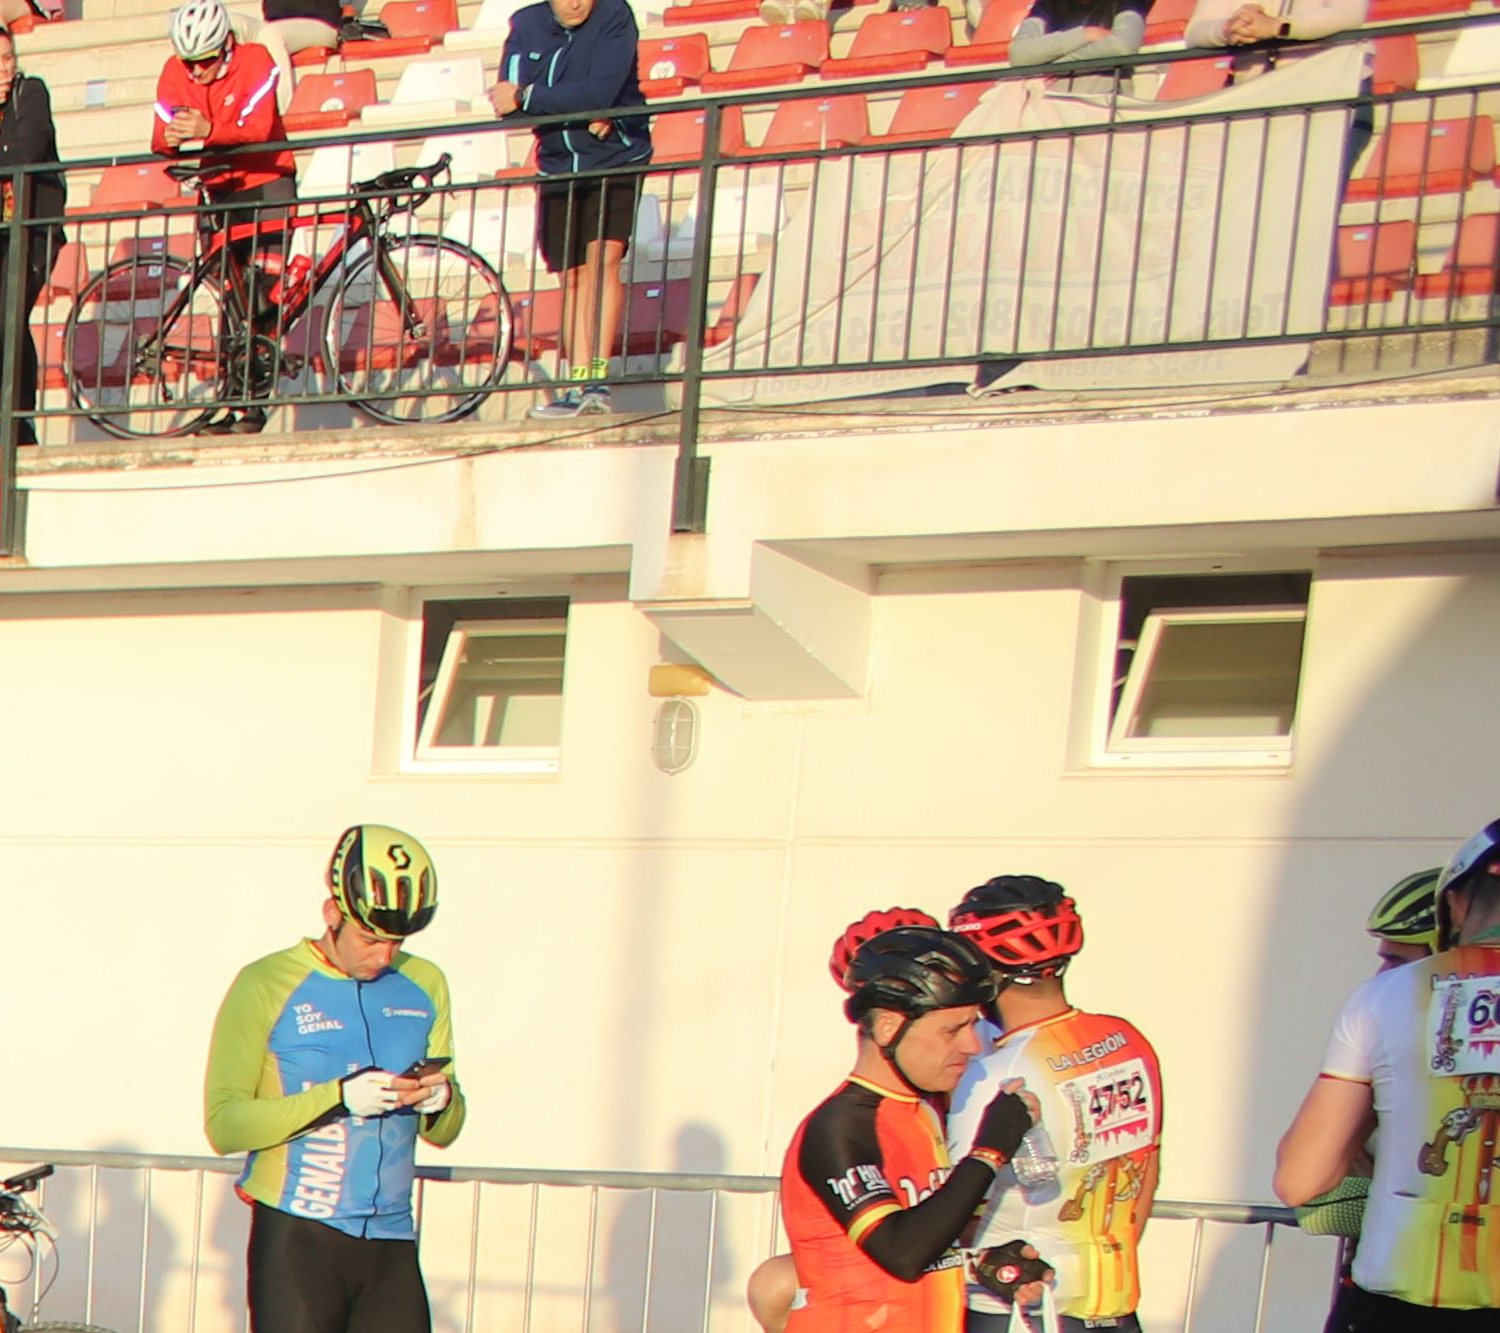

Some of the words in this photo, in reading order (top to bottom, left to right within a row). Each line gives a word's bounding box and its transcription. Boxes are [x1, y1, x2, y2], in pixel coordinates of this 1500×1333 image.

[292, 1003, 312, 1015] YO
[295, 1012, 322, 1026] SOY
[297, 1020, 344, 1035] GENAL
[1046, 1051, 1073, 1073] LA
[1087, 1074, 1147, 1118] 4752
